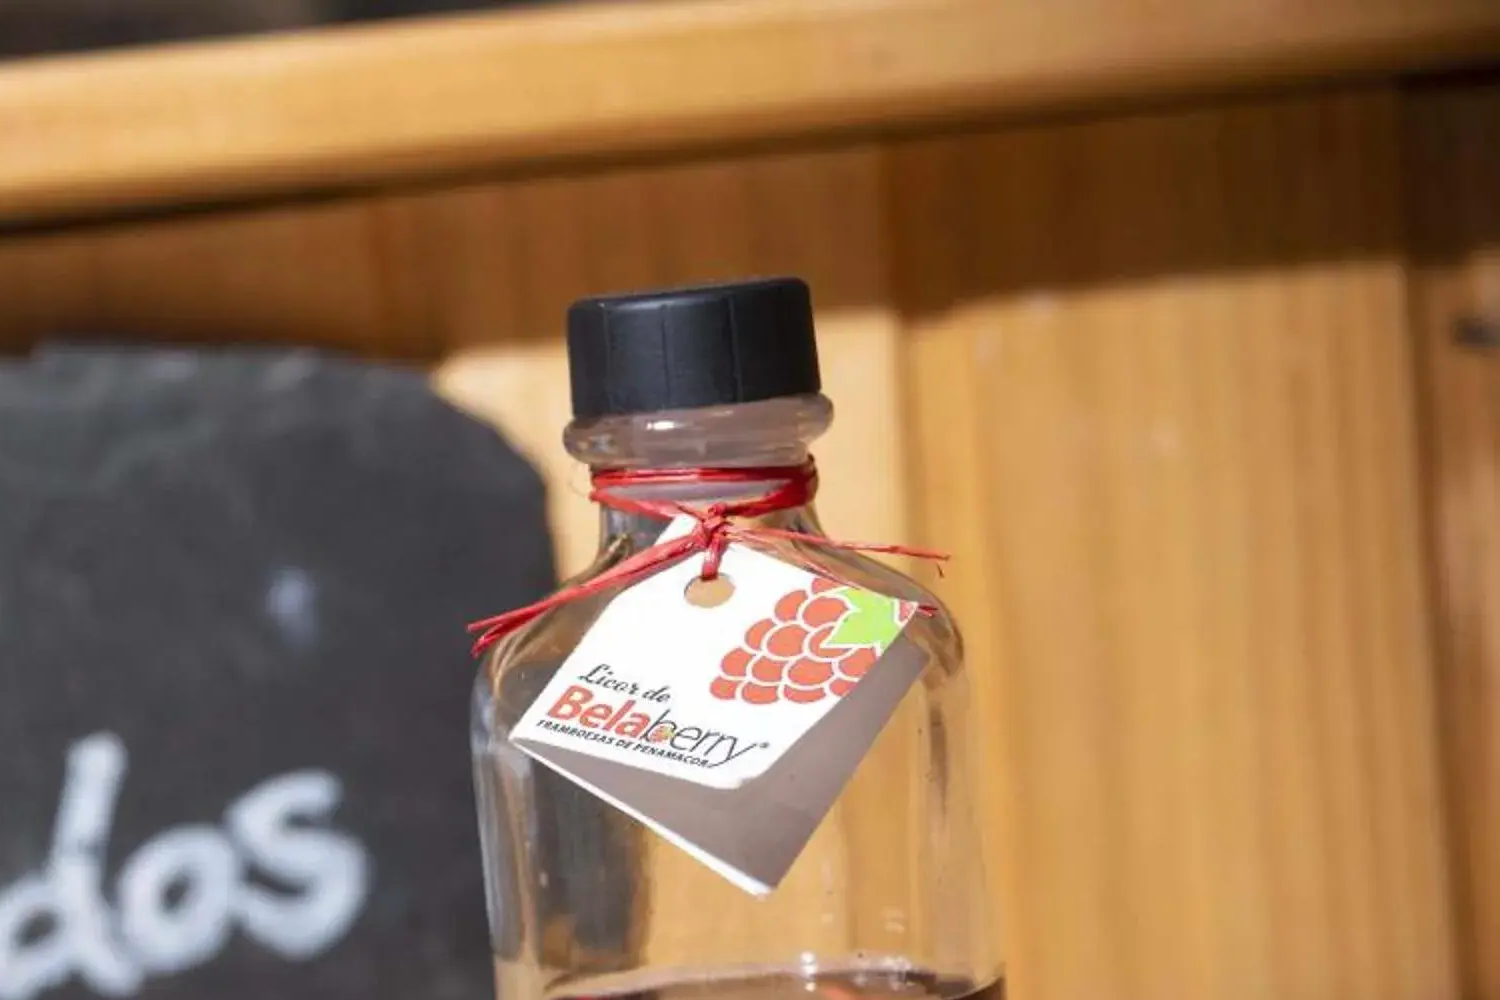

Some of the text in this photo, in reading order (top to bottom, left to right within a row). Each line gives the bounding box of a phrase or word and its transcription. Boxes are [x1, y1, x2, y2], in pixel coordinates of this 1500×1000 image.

[577, 663, 671, 703] Licor de
[537, 719, 613, 746] FRAMBOESAS
[615, 738, 633, 750] DE
